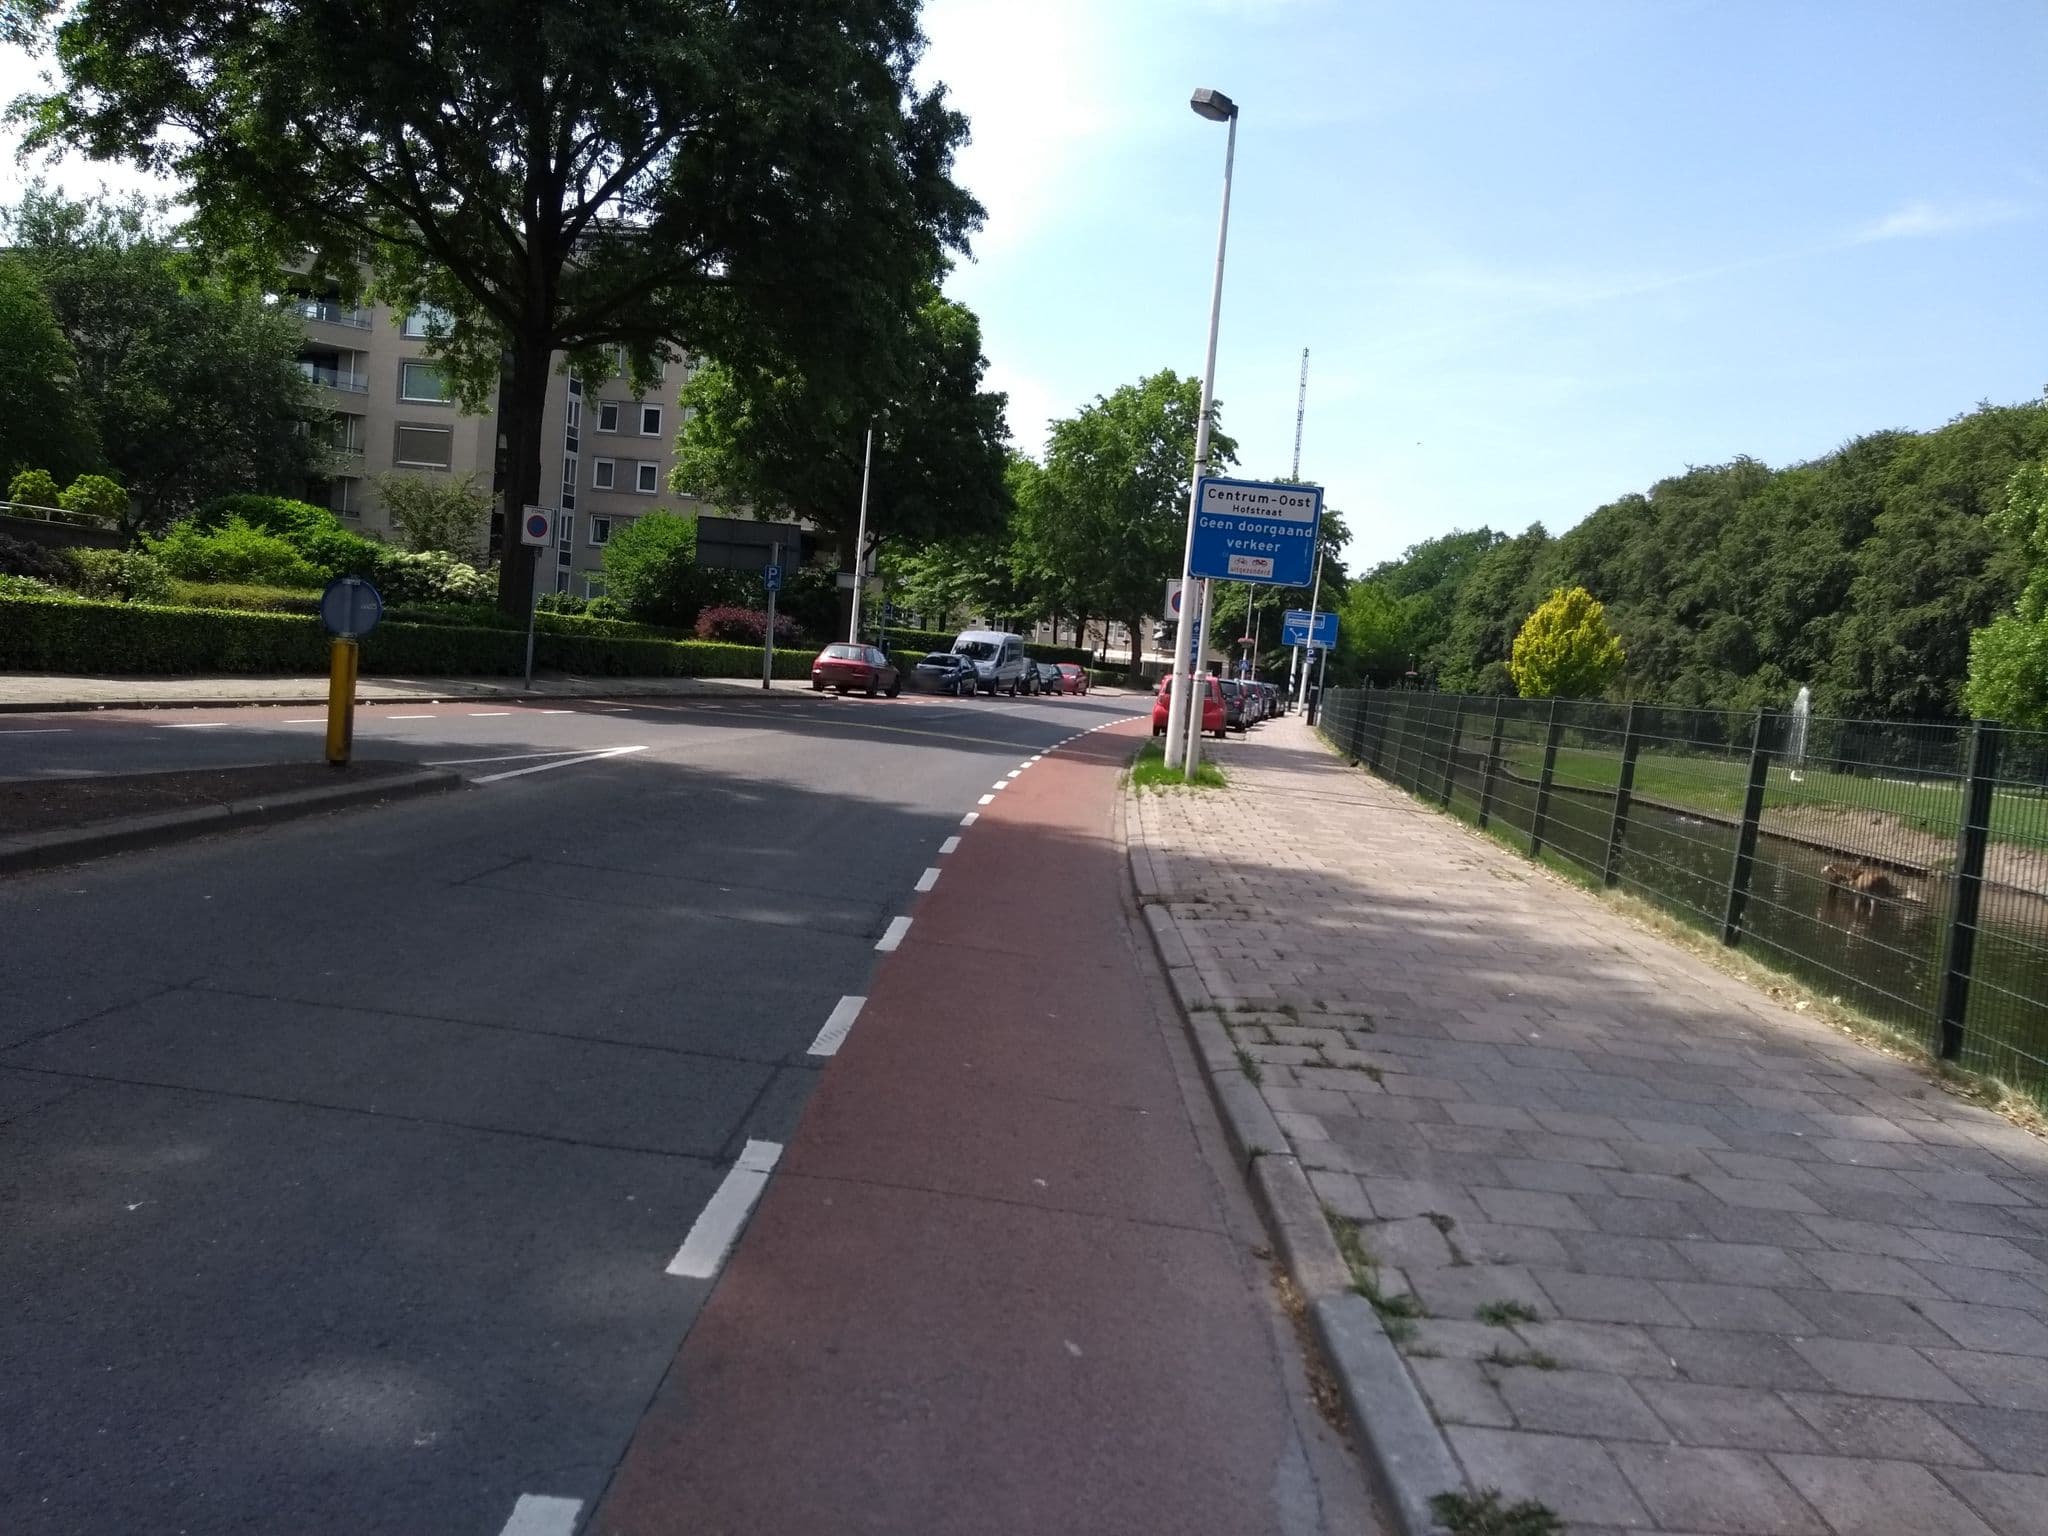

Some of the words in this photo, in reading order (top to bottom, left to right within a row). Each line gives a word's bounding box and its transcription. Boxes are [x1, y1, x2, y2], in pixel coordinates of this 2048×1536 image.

[1208, 488, 1311, 508] Centrum-Oost
[1232, 504, 1282, 517] Hofstraat
[1199, 516, 1233, 530] Geen
[1238, 520, 1313, 538] doorgaand
[1226, 538, 1281, 553] verkeer
[768, 567, 778, 580] P
[1307, 649, 1314, 657] P
